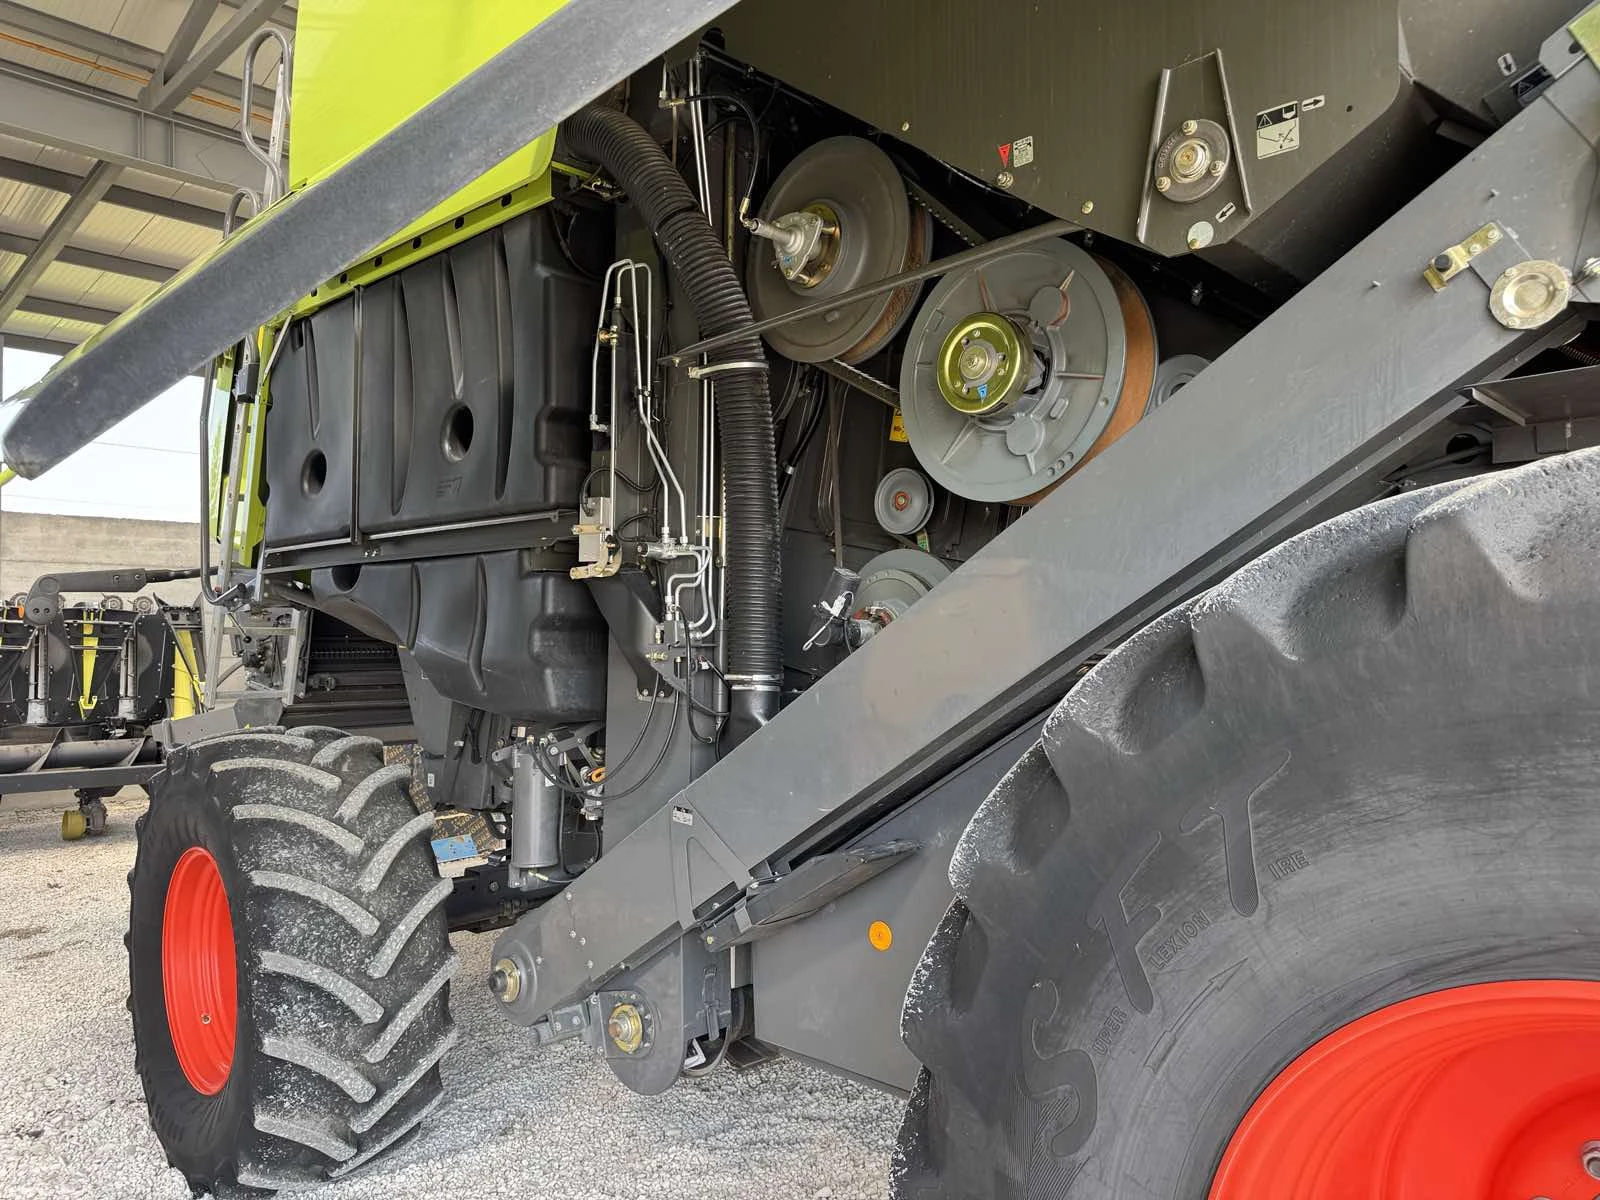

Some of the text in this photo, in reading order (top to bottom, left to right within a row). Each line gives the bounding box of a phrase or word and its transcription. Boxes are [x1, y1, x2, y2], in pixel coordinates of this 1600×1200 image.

[1267, 850, 1311, 881] IRE
[1149, 909, 1211, 969] LEXION
[1092, 1005, 1129, 1056] UPER
